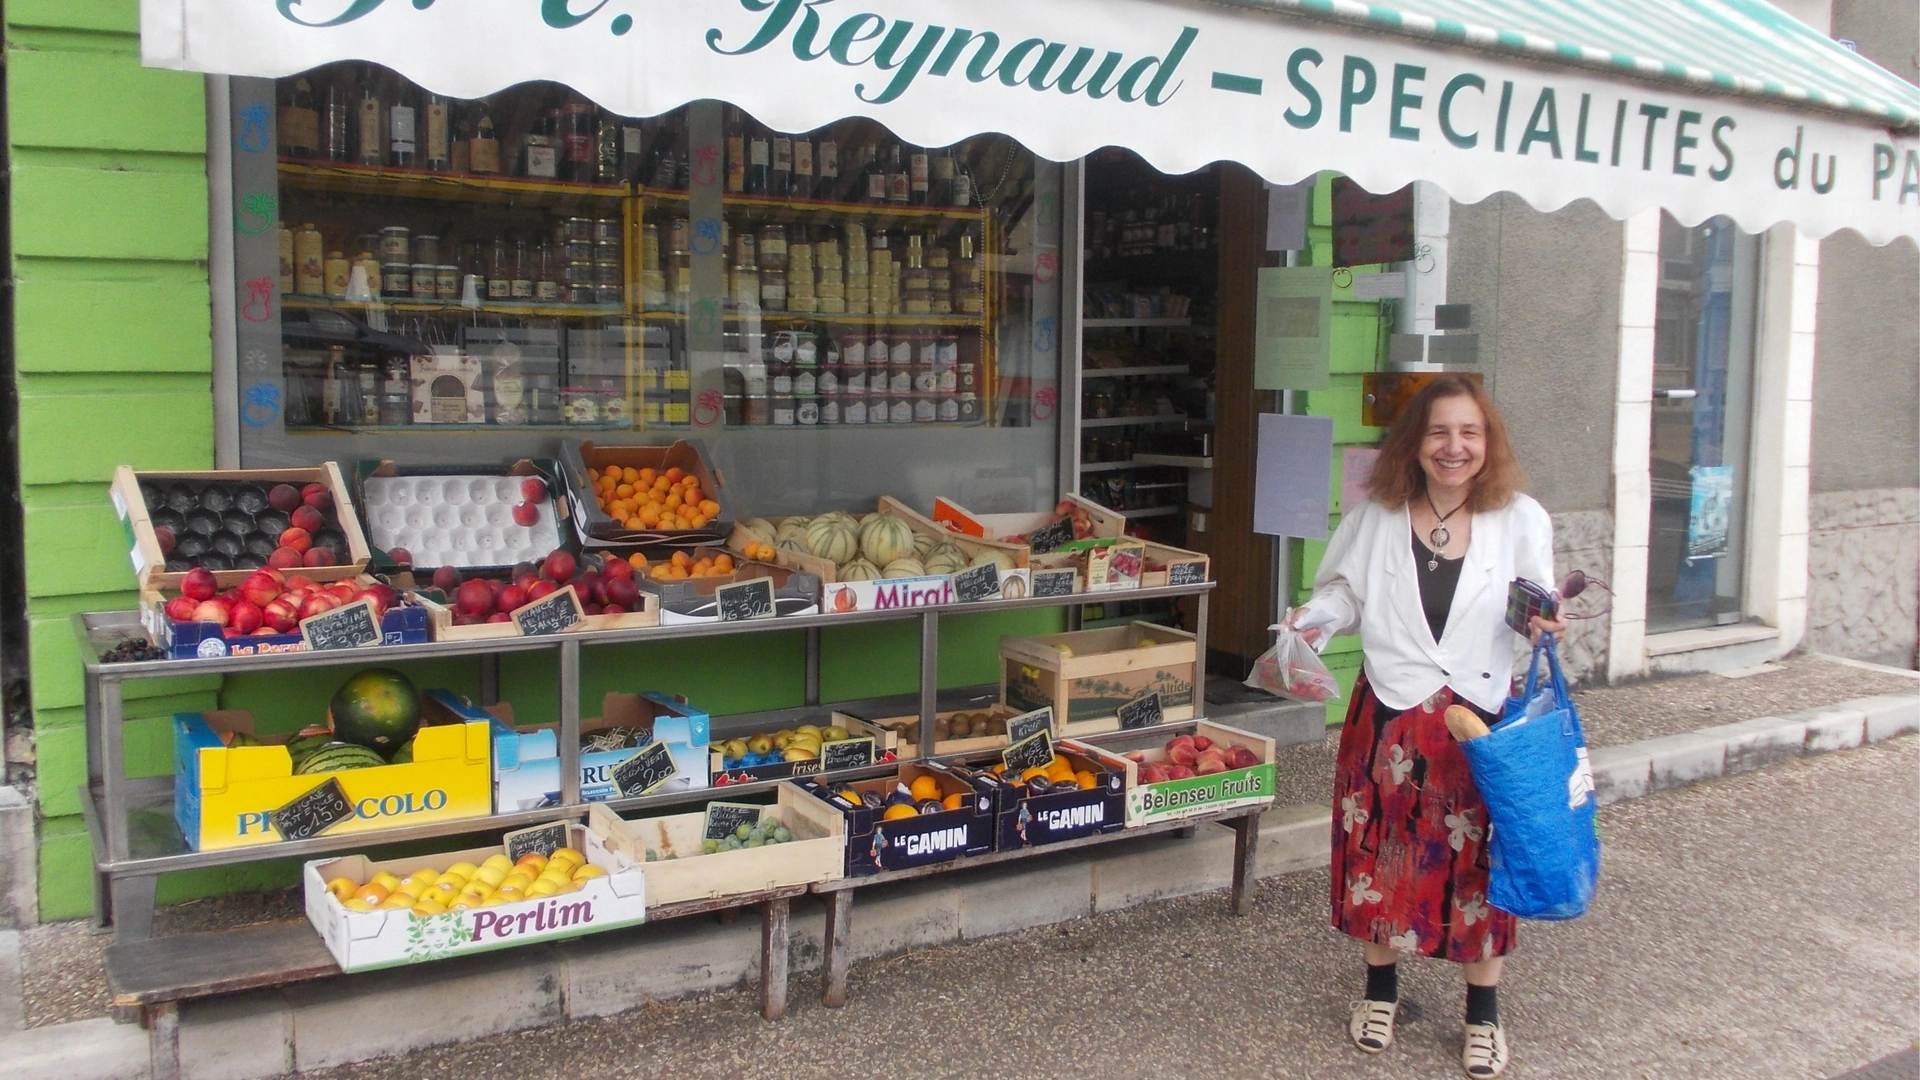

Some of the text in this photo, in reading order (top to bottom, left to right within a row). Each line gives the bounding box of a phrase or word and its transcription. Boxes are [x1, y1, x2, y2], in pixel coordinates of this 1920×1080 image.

[1283, 47, 1736, 182] SPECIALITES
[1773, 125, 1836, 195] du
[1143, 785, 1216, 811] Belenseu
[1221, 773, 1262, 797] Fruits
[1038, 802, 1104, 830] LE GAMIN
[894, 824, 967, 855] LE GAMIN
[471, 900, 594, 942] Perlim
